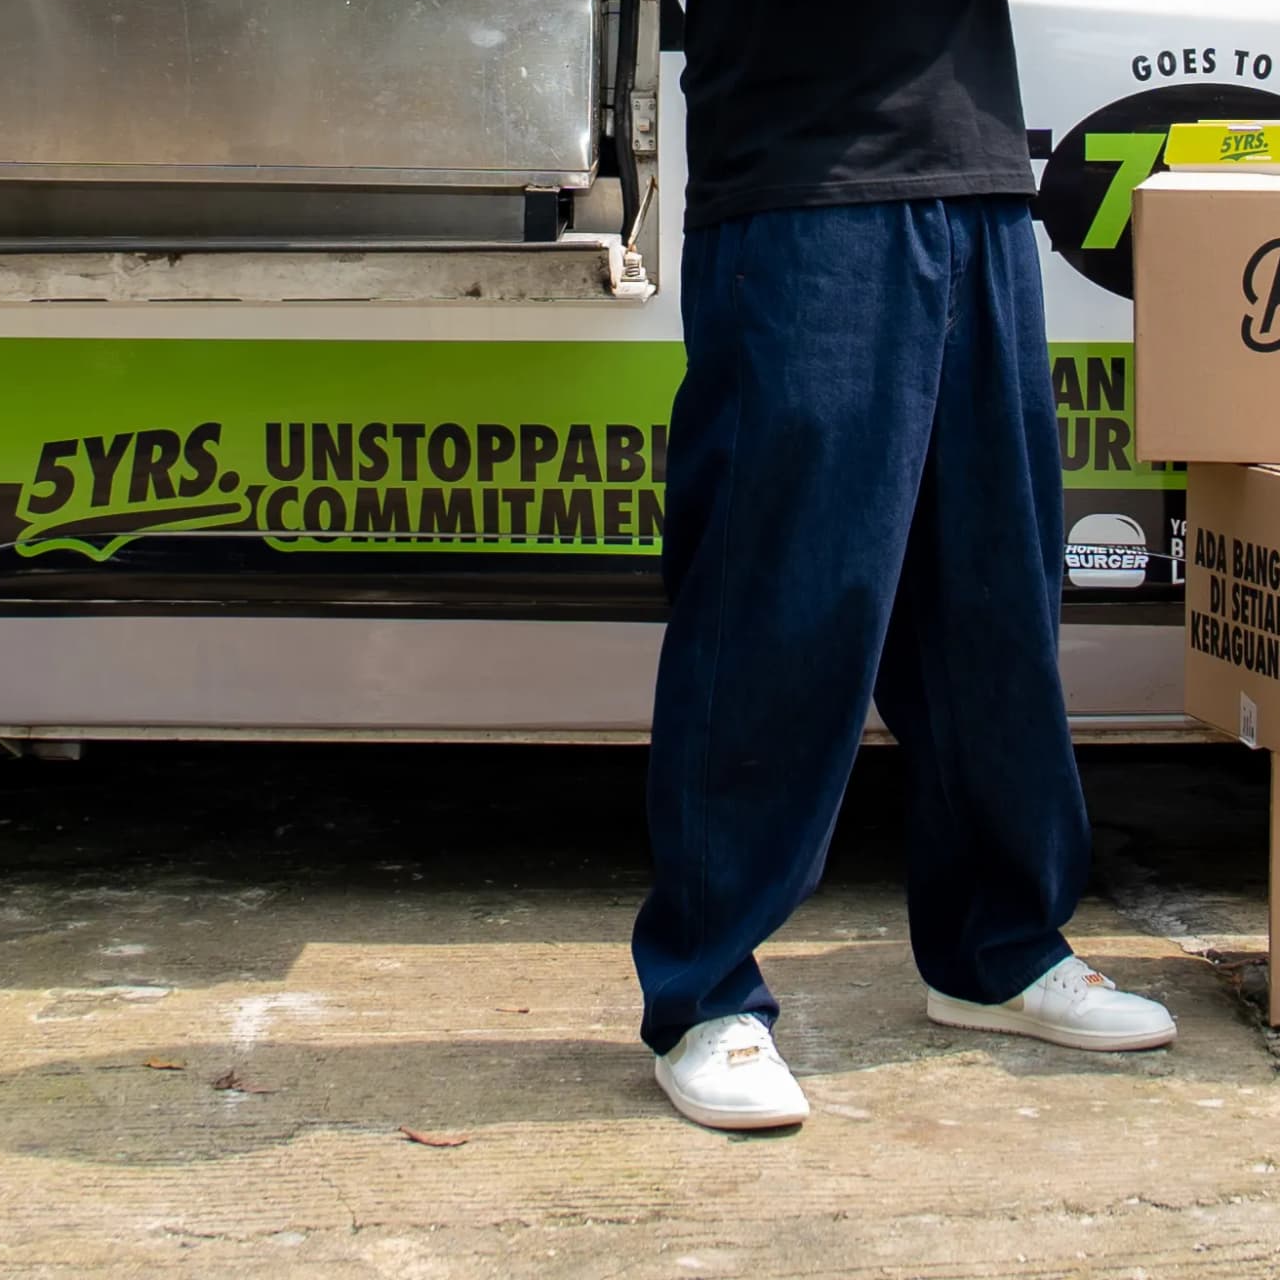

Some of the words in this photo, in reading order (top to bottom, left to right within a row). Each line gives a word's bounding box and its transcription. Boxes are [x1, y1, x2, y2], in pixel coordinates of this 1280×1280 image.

[1132, 47, 1216, 82] GOES
[1233, 49, 1273, 80] TO
[1221, 133, 1269, 153] 5YRS.
[27, 422, 241, 516] 5YRS.
[265, 422, 667, 483] UNSTOPPABL
[265, 486, 665, 546] COMMITMEN
[1065, 554, 1149, 570] BURGER
[1195, 528, 1227, 574] ADA
[1210, 574, 1227, 617] DI
